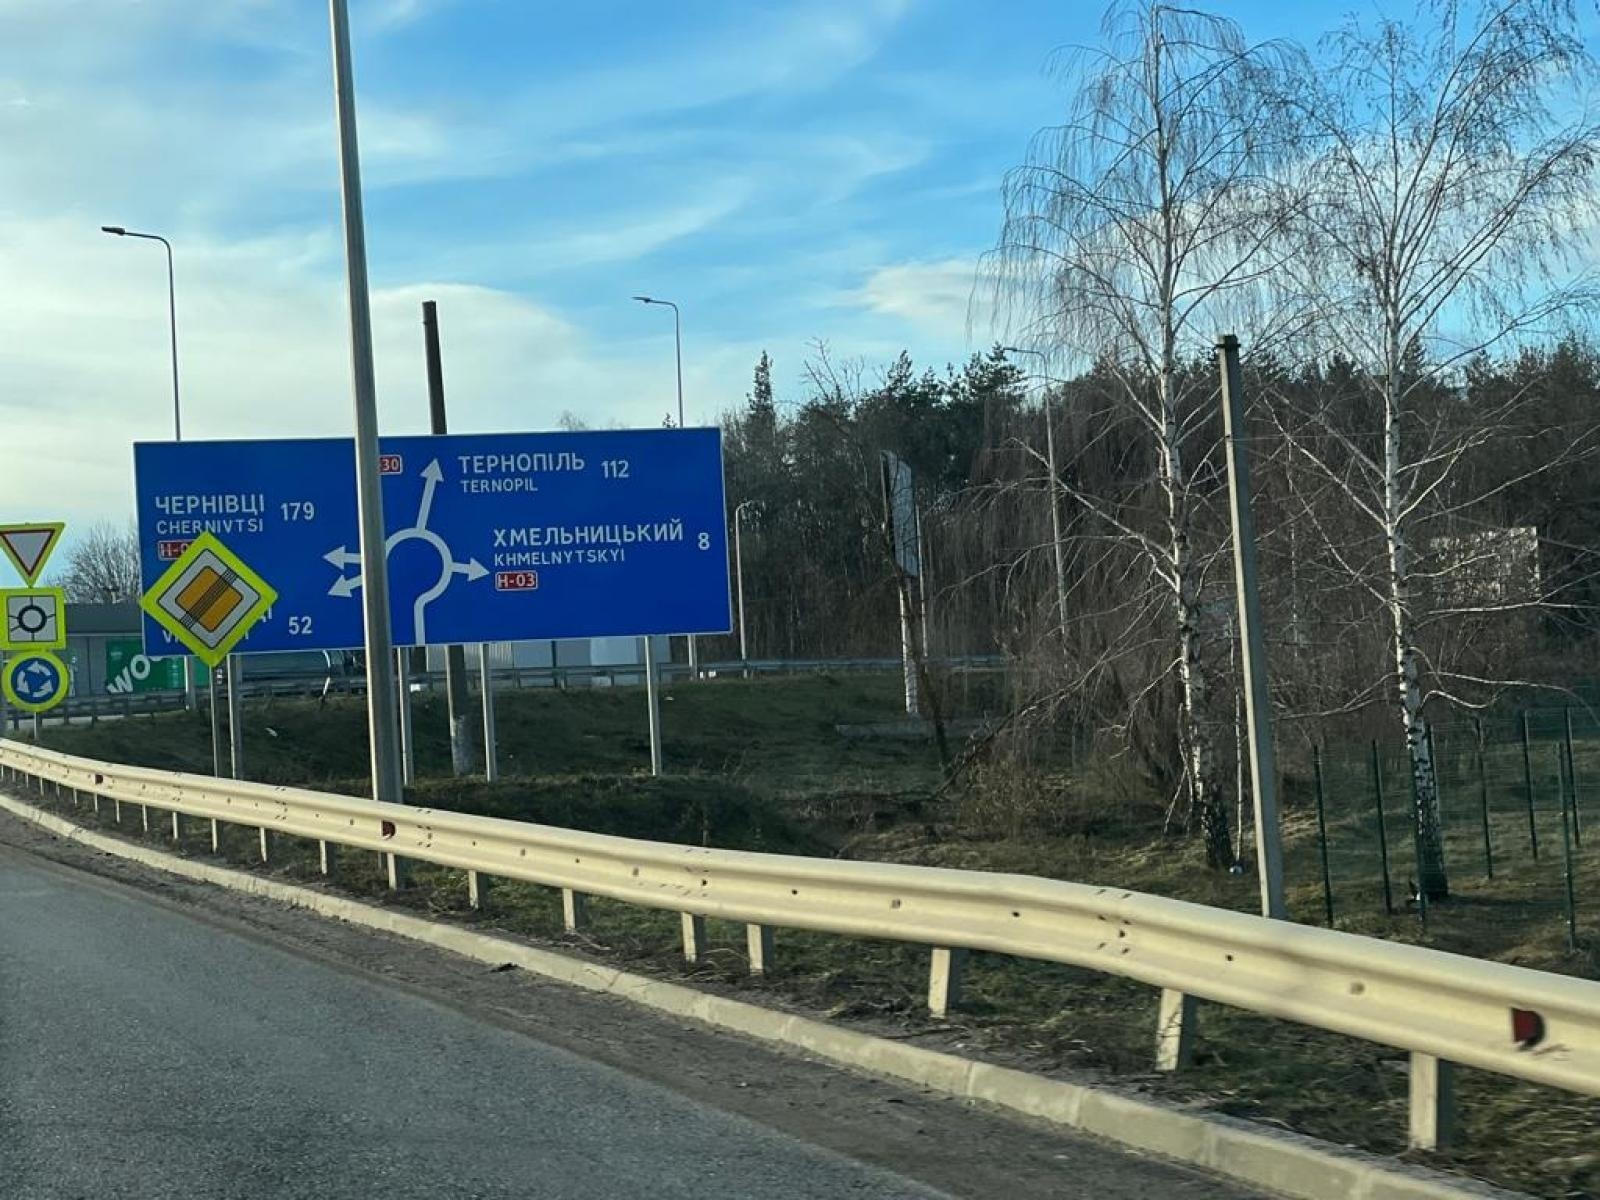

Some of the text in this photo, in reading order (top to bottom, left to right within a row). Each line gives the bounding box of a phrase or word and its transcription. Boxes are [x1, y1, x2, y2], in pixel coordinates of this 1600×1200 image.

[458, 452, 629, 479] ТЕРНОПІЛЬ 112
[460, 479, 538, 493] TERNOPIL
[156, 494, 315, 520] ЧЕРНІВЦІ 179
[156, 519, 263, 534] CHERNIVTSI
[493, 518, 710, 550] ХМЕЛЬНИЦЬКИЙ 8
[494, 549, 625, 567] KHMELNYTSKYI
[288, 616, 313, 635] 52
